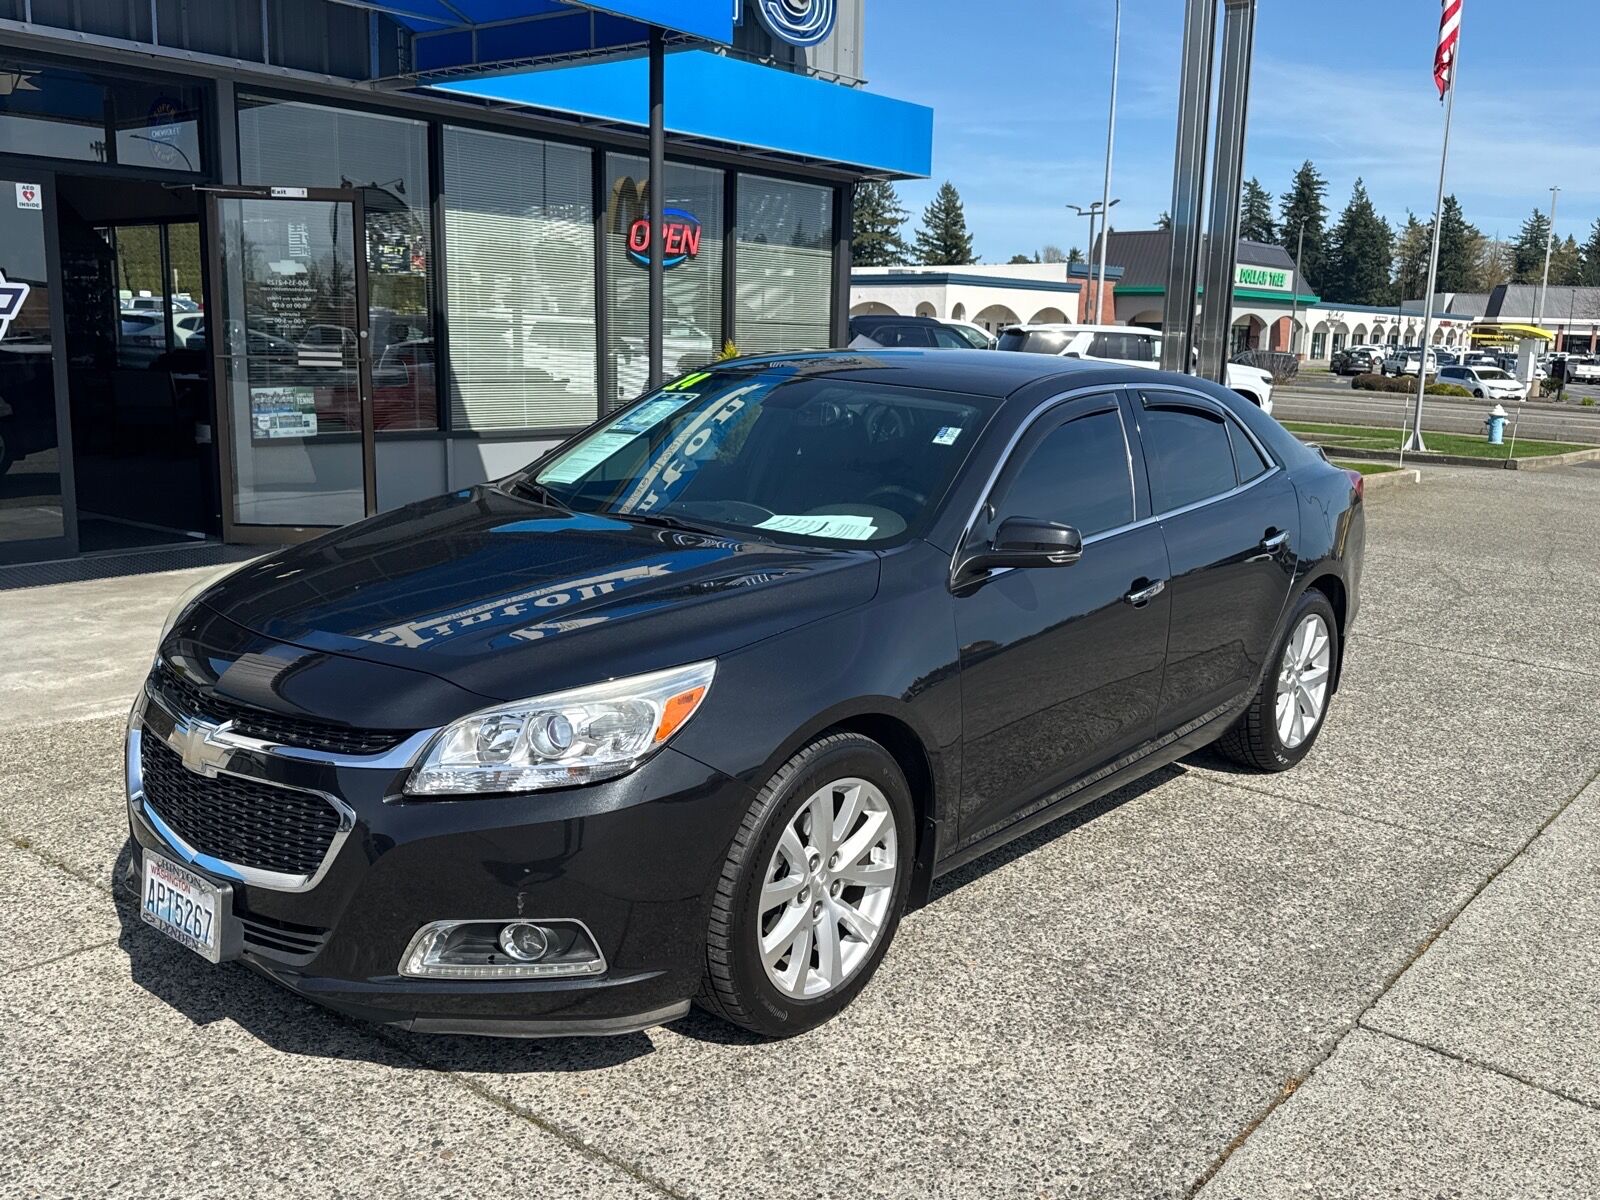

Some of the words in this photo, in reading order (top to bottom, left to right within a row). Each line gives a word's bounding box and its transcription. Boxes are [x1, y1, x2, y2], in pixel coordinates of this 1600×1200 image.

[19, 201, 40, 209] INSIDE
[629, 220, 701, 255] OEN
[1239, 268, 1268, 286] DOLLAR
[1268, 271, 1287, 287] TREE
[150, 864, 191, 894] WASHINGTON
[147, 878, 213, 944] APT5267
